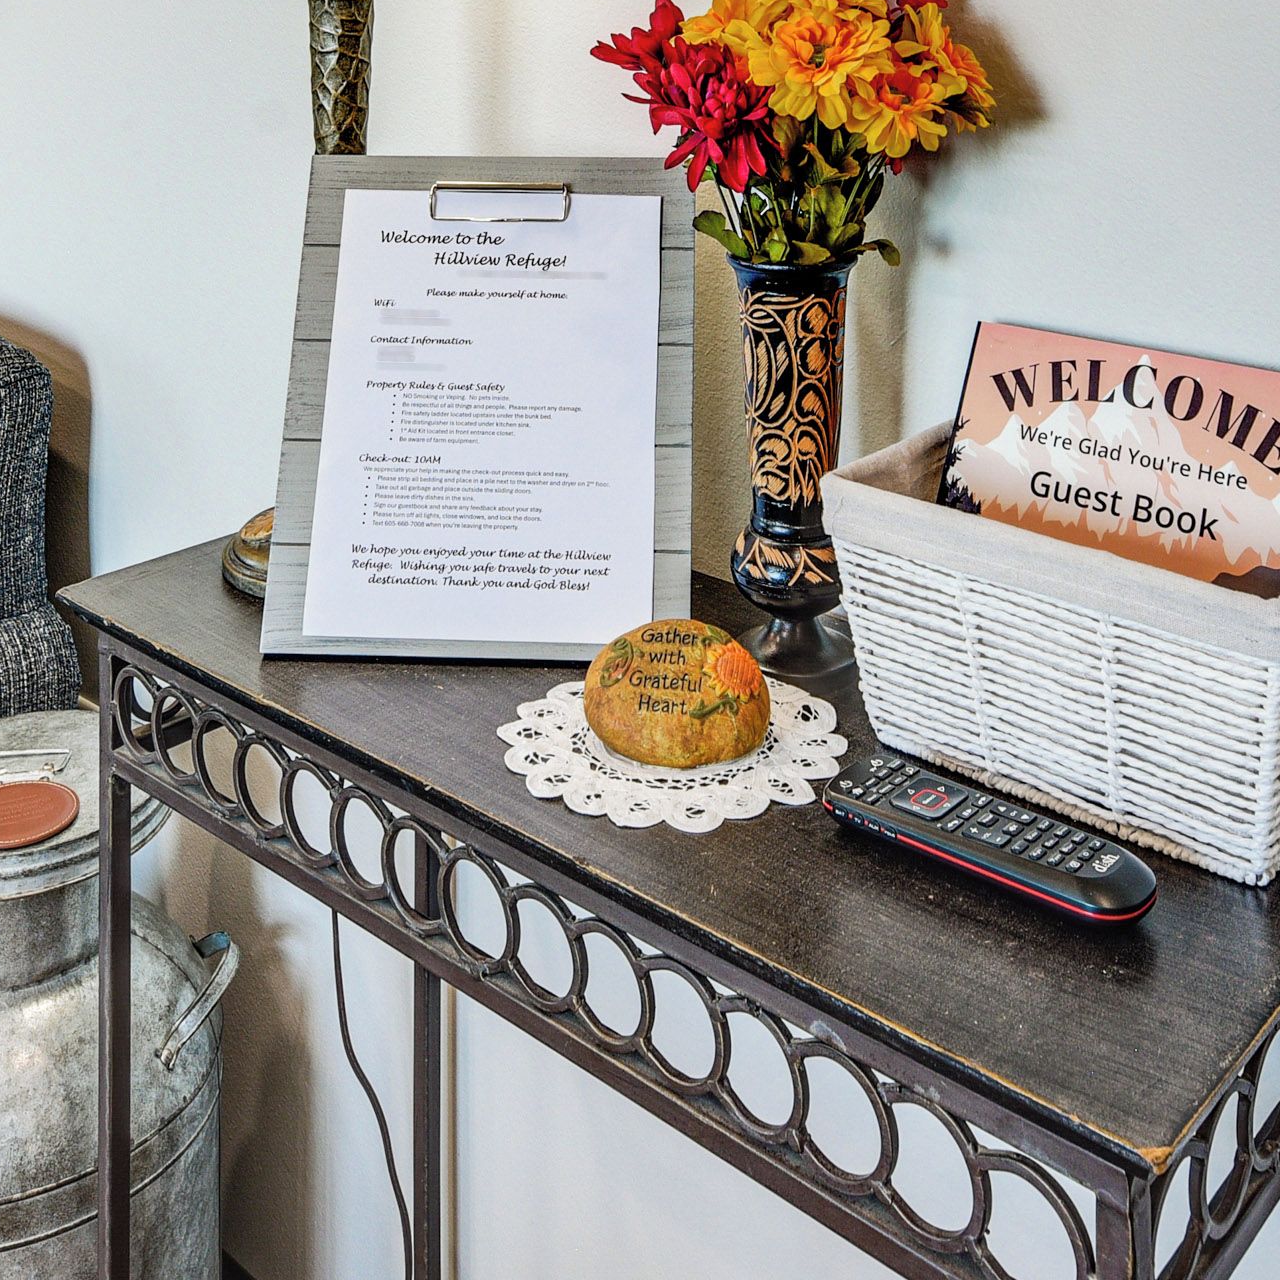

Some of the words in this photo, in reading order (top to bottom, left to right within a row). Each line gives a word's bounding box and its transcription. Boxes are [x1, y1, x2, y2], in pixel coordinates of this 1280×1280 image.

[381, 230, 454, 243] Welcome
[455, 232, 476, 244] to
[476, 231, 505, 245] the
[434, 251, 502, 265] Hillview
[504, 253, 567, 270] Refuge!
[426, 288, 457, 296] Please
[458, 288, 486, 296] make
[485, 289, 526, 299] yourself
[374, 298, 396, 307] WiFi
[410, 336, 473, 344] Information
[366, 380, 407, 390] Property
[408, 381, 436, 390] Rules
[435, 382, 445, 390] &
[447, 382, 475, 390] Guest
[474, 382, 505, 393] Safety
[359, 453, 412, 462] Check-out:
[413, 455, 441, 463] 10AM
[1019, 423, 1072, 450] We're
[1078, 437, 1121, 462] Glad
[1127, 448, 1191, 477] You're
[1197, 463, 1248, 491] Here
[1029, 470, 1122, 517] Guest
[1132, 493, 1219, 540] Book
[351, 543, 369, 553] We
[369, 543, 400, 557] hope
[399, 547, 422, 556] you
[422, 546, 469, 559] enjoyed
[468, 549, 497, 559] your
[498, 549, 527, 558] time
[527, 550, 543, 558] at
[542, 549, 564, 559] the
[564, 550, 611, 560] Hillview
[400, 560, 447, 573] Wishing
[446, 564, 472, 573] you
[472, 562, 497, 573] safe
[497, 563, 538, 574] travels
[538, 565, 553, 576] to
[552, 567, 581, 577] your
[583, 567, 610, 575] next
[442, 575, 481, 586] Thank
[480, 580, 505, 590] you
[505, 578, 531, 588] and
[530, 575, 558, 589] God
[557, 579, 590, 590] Bless!
[641, 628, 699, 646] Gather
[649, 650, 686, 665] with
[629, 669, 702, 692] Grateful
[638, 694, 687, 715] Heart
[1092, 853, 1120, 873] dish
